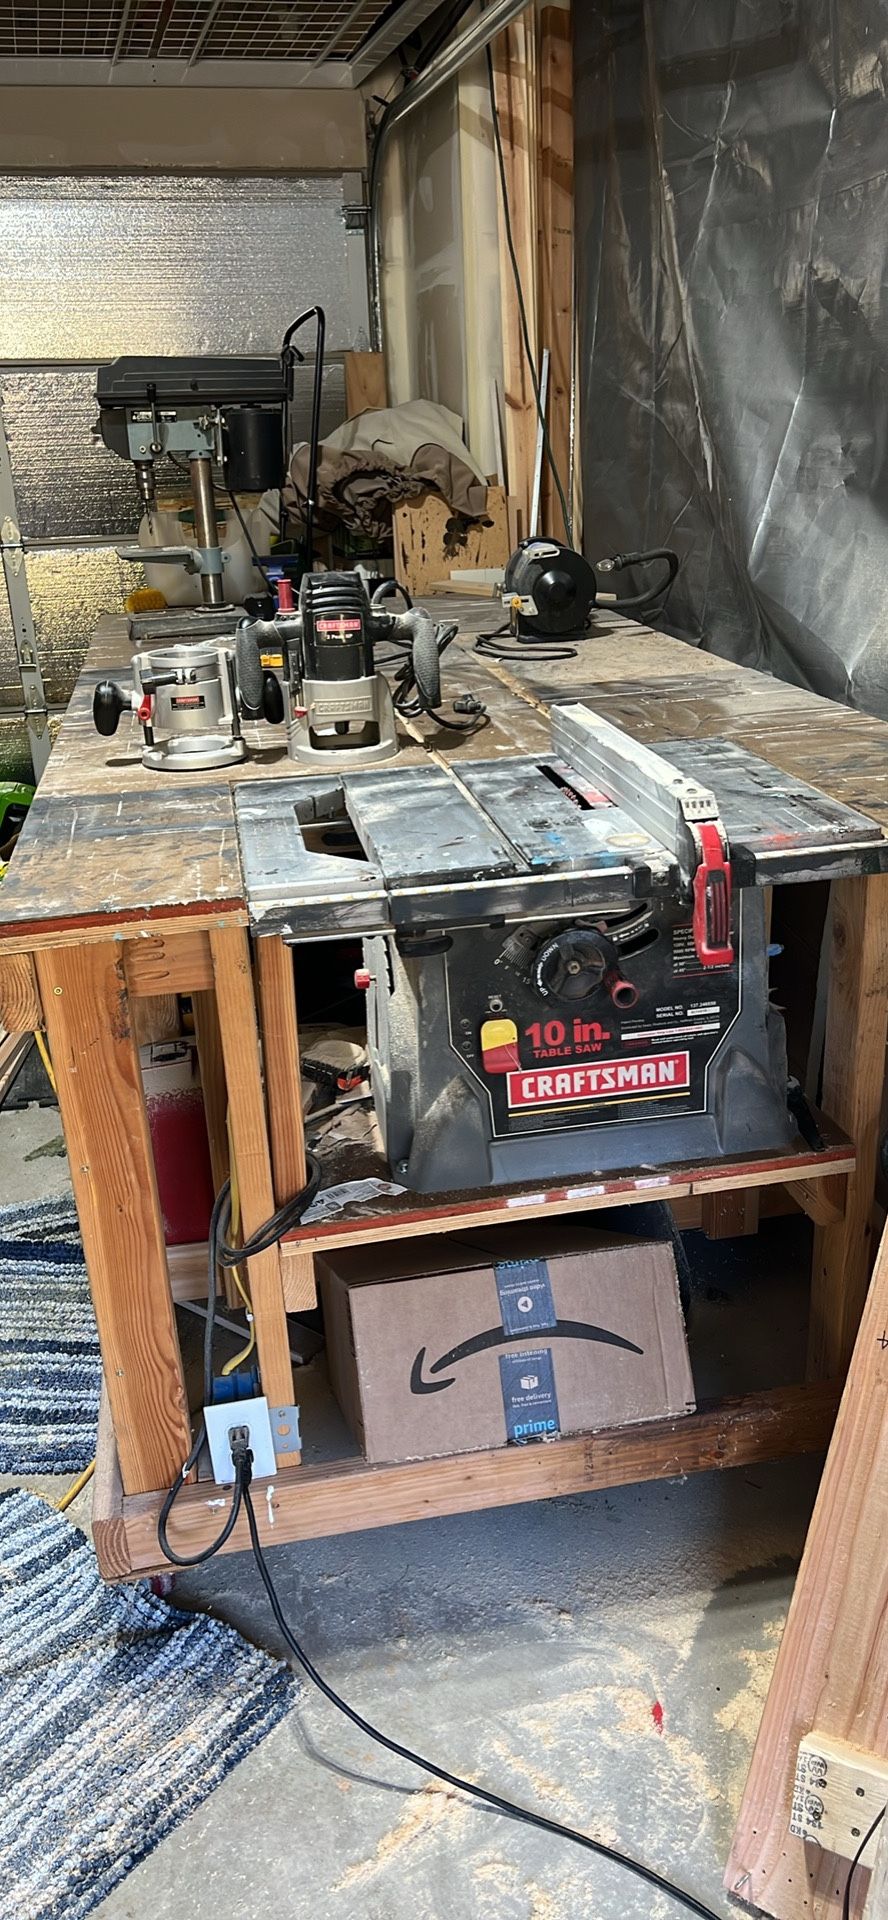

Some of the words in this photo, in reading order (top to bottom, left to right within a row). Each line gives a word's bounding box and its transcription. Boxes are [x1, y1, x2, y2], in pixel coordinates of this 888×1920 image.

[318, 700, 371, 712] CRAFTSMAN
[540, 942, 560, 963] DOWN
[539, 986, 549, 997] UP
[525, 1020, 566, 1049] 10
[573, 1018, 611, 1043] in.
[533, 1047, 572, 1059] TABLE
[575, 1043, 603, 1054] SAW
[521, 1060, 677, 1099] CRAFTSMAN
[525, 1391, 552, 1402] delivery
[513, 1419, 556, 1438] prime
